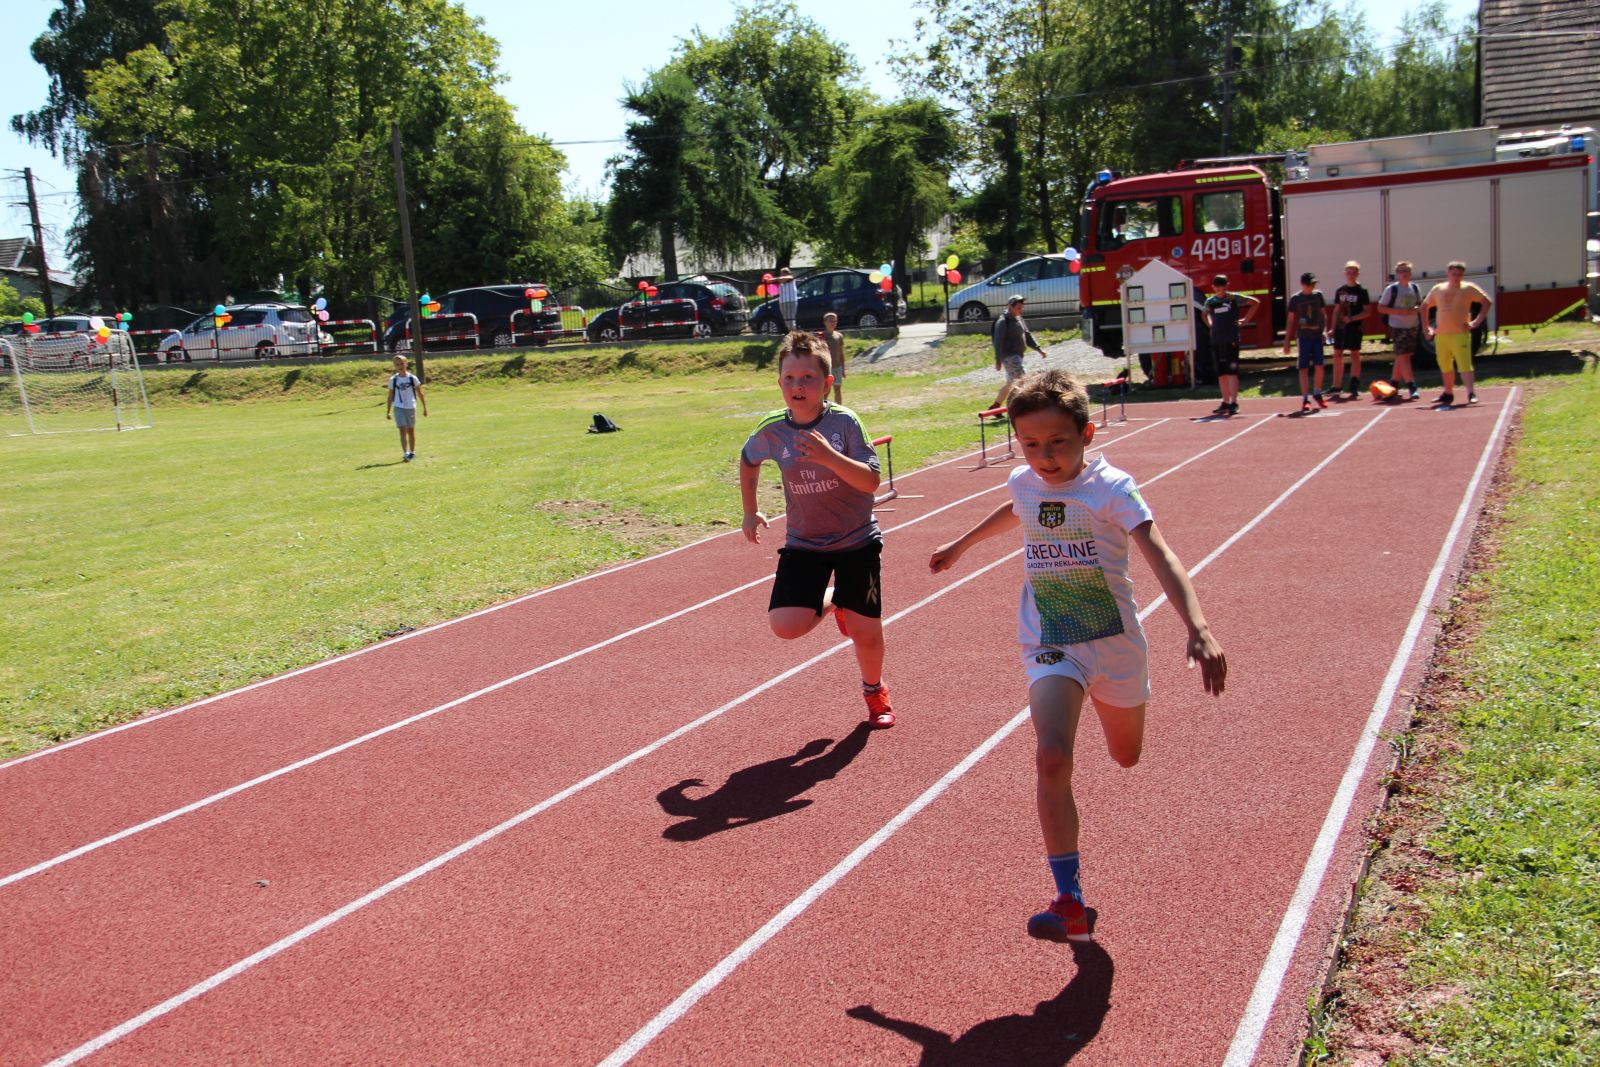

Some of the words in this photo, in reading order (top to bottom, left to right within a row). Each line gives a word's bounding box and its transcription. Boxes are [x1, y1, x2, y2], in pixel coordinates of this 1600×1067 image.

[800, 469, 816, 480] Fly
[789, 478, 839, 495] Emirates
[1026, 540, 1098, 560] CREDLINE
[1054, 557, 1100, 568] REKLAMOWE
